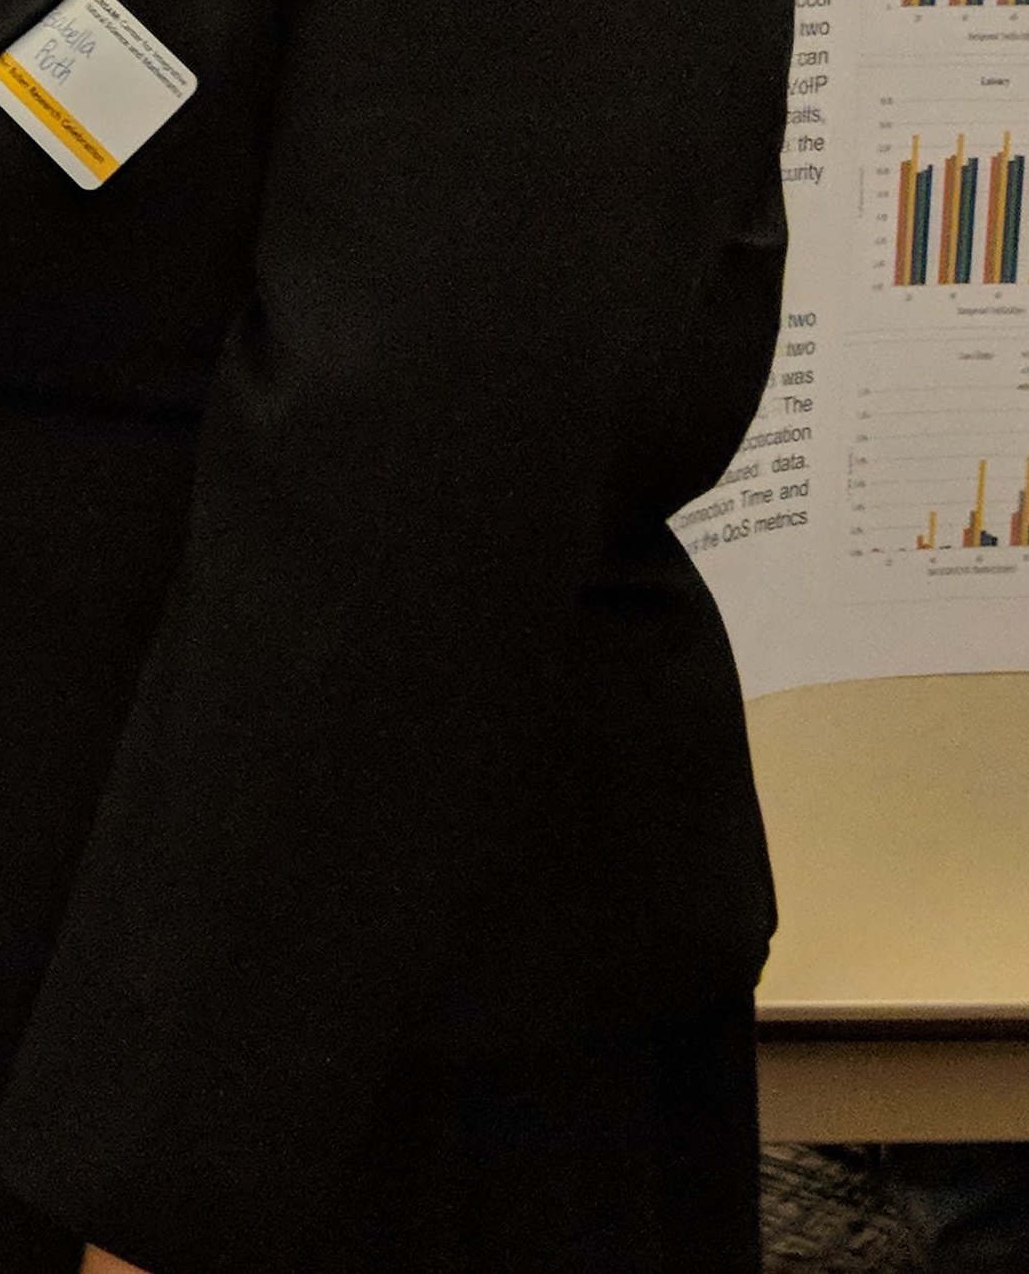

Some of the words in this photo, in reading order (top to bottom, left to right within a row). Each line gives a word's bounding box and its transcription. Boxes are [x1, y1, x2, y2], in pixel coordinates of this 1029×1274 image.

[42, 10, 96, 59] sabella
[800, 22, 830, 35] two
[34, 38, 75, 84] Roth
[797, 50, 828, 66] can
[798, 136, 824, 151] the
[788, 312, 816, 328] two
[787, 341, 815, 356] two
[782, 370, 814, 386] was
[784, 395, 813, 413] The
[741, 488, 773, 508] Time
[780, 480, 809, 499] and
[723, 520, 750, 543] QoS
[754, 511, 807, 533] metrics
